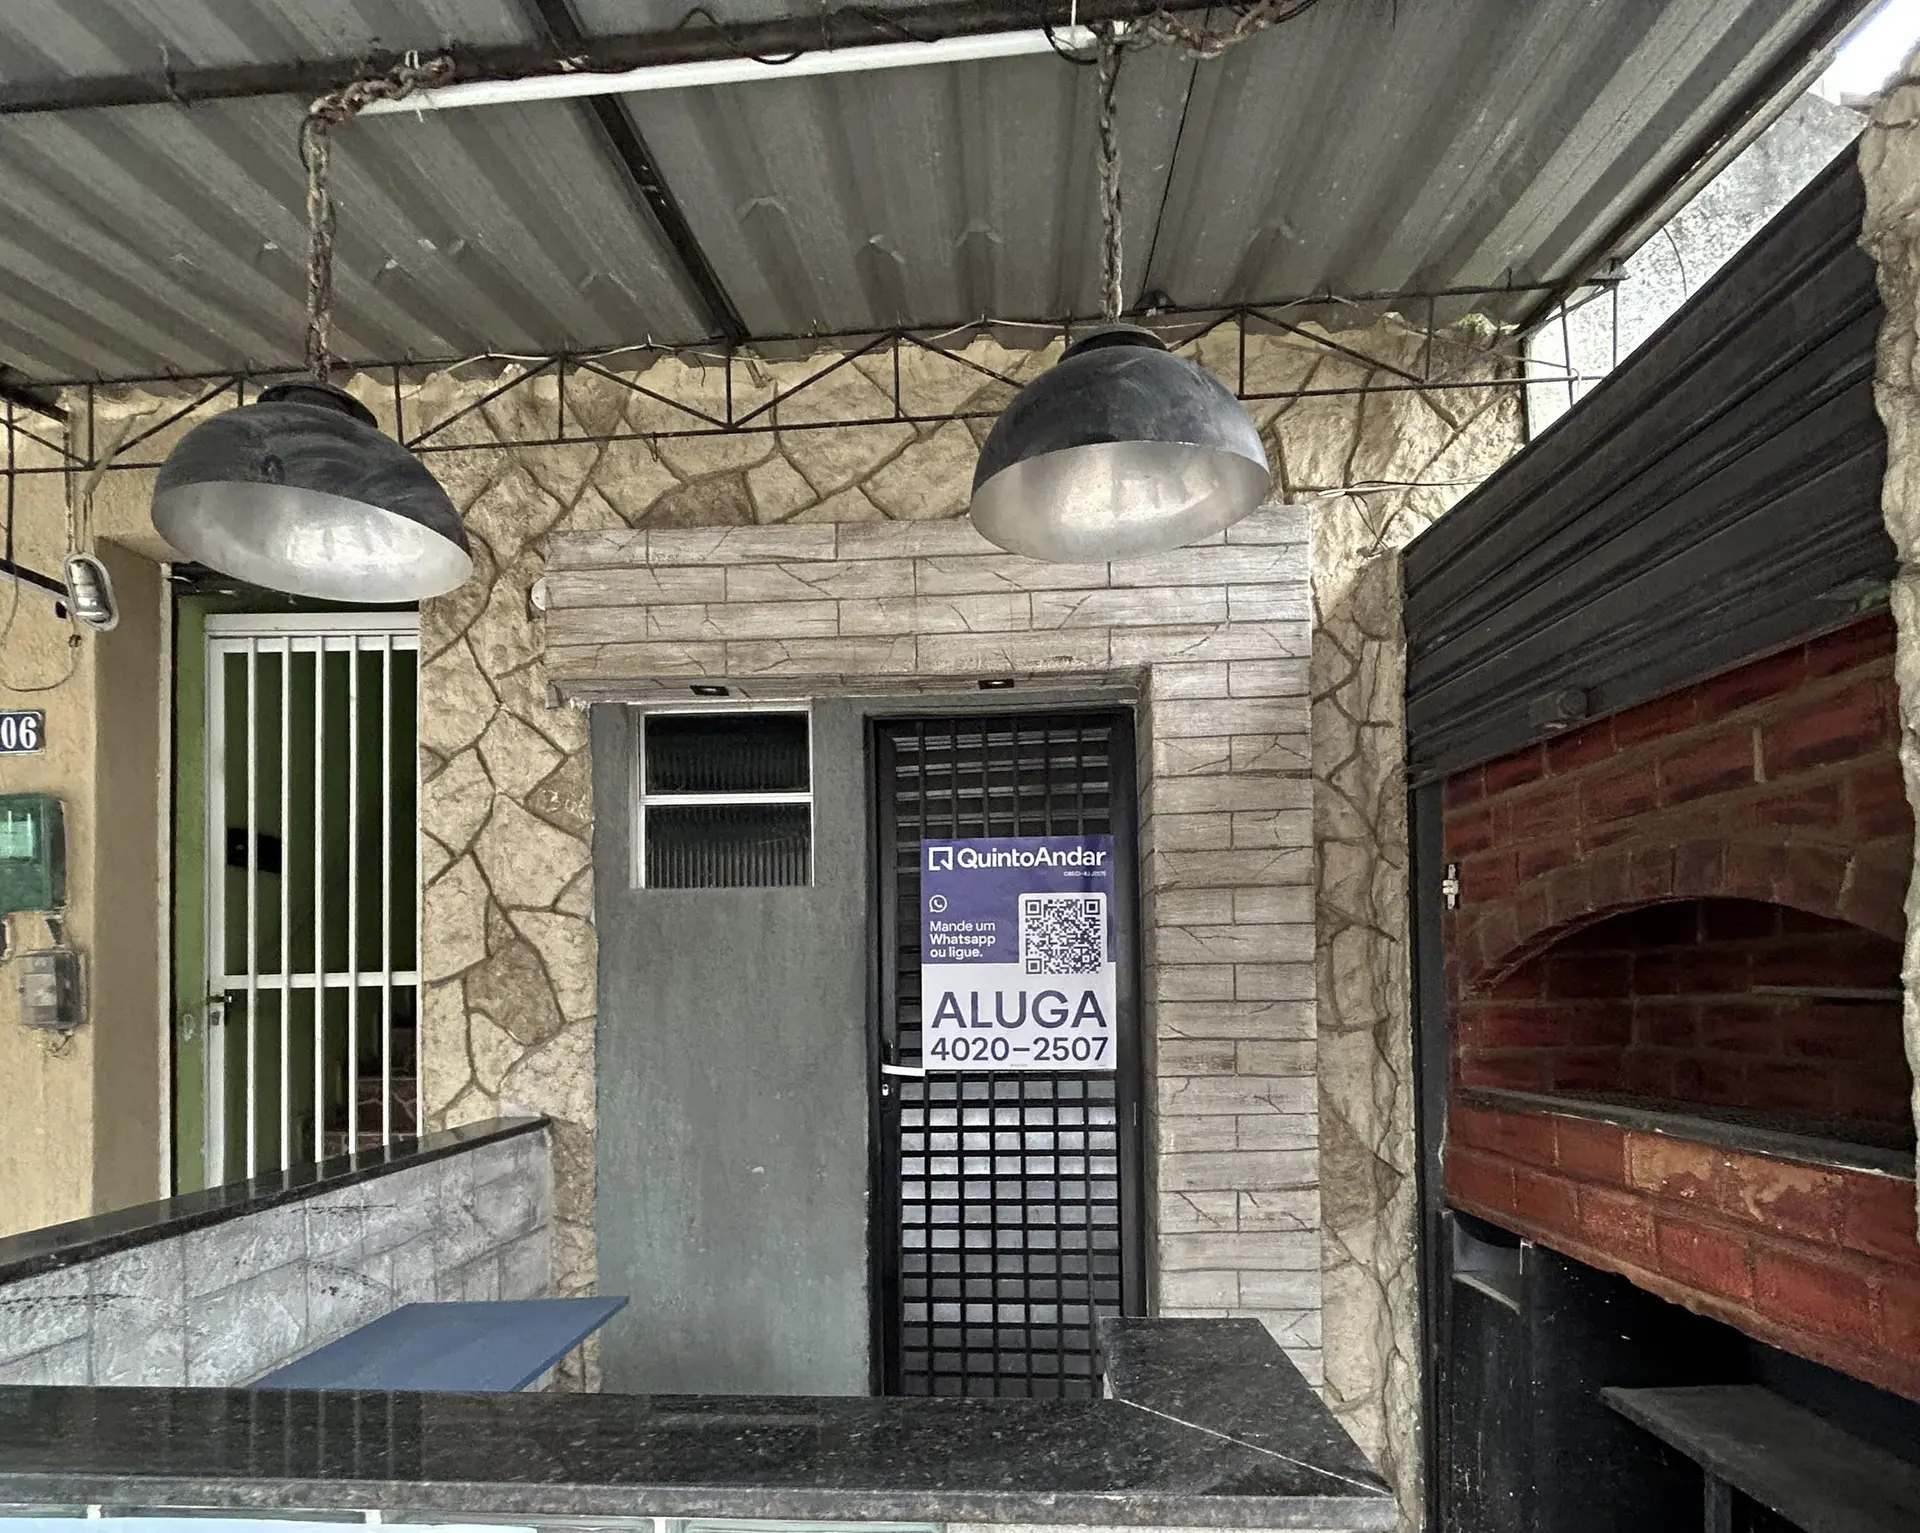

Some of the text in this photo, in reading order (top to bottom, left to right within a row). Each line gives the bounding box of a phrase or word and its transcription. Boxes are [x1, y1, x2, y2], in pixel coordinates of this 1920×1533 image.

[1, 716, 37, 749] 06
[957, 846, 1107, 870] QuintoAndar
[930, 921, 996, 932] Mande um
[930, 933, 996, 947] Whatsapp
[930, 946, 983, 960] ou ligue.
[931, 990, 1107, 1028] ALUGA
[930, 1037, 1108, 1061] 4020-2507
